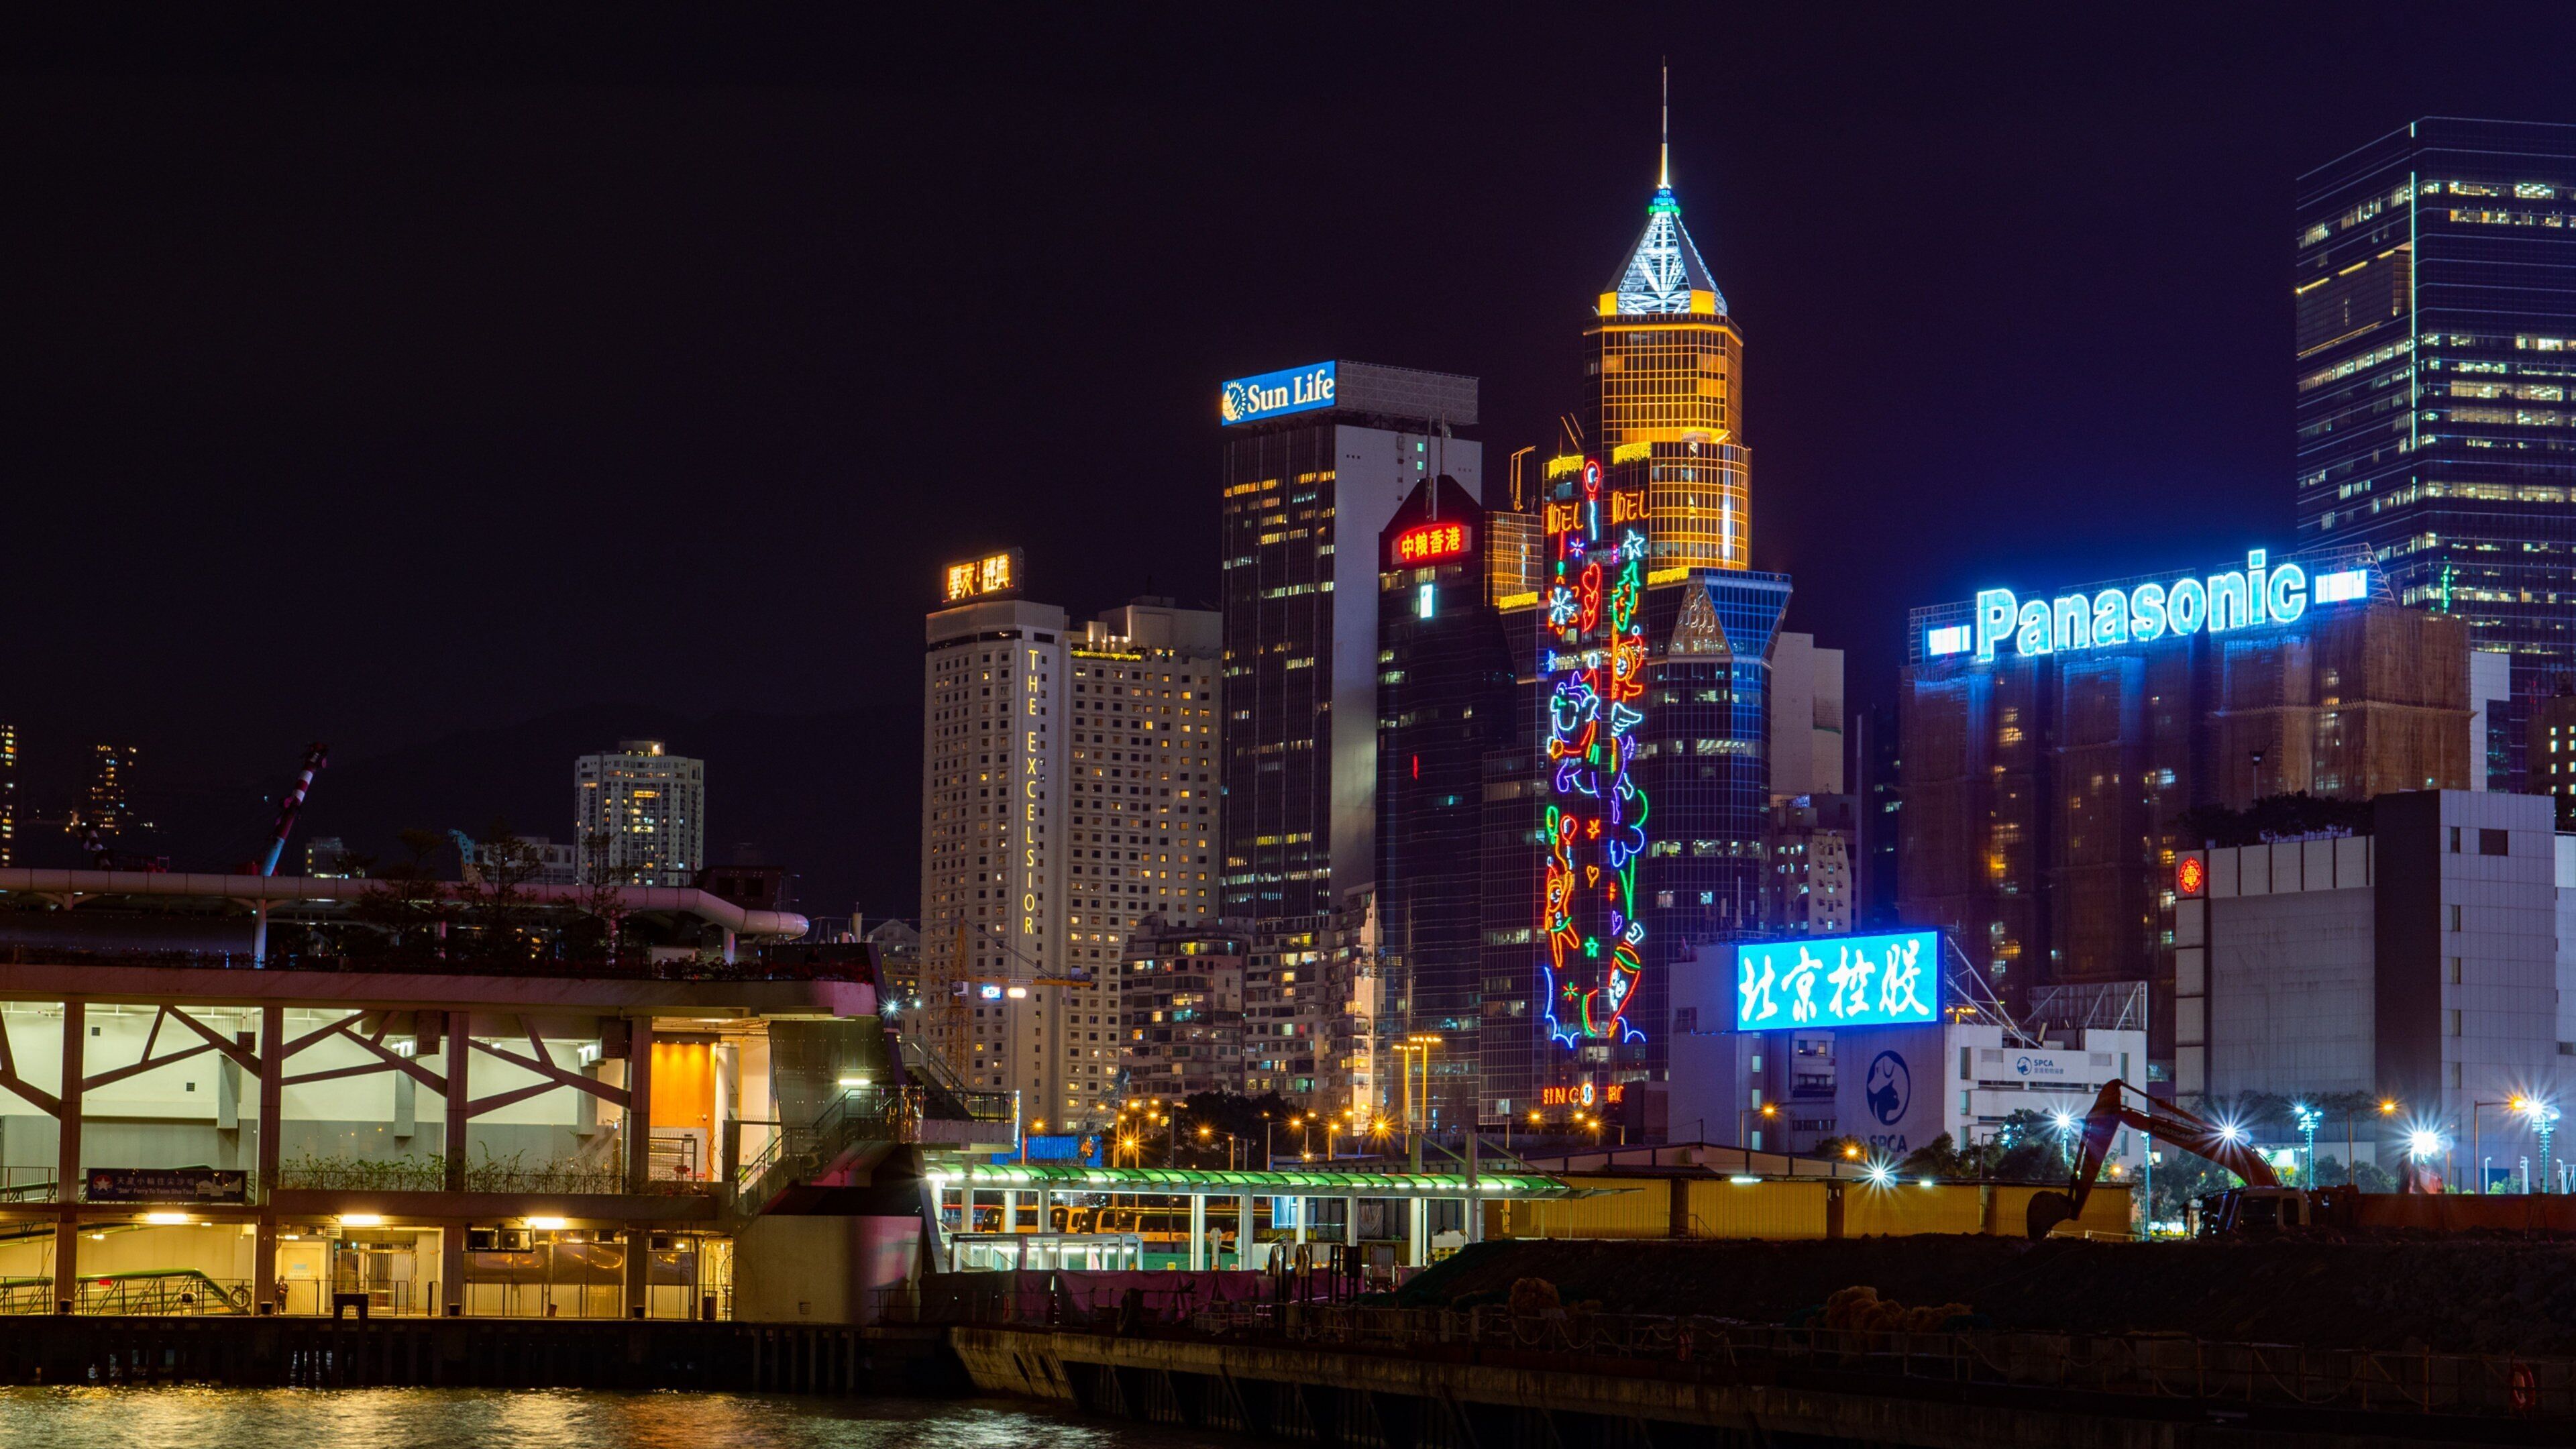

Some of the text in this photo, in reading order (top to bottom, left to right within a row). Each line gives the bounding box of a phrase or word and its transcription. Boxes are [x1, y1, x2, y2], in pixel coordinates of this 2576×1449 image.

[1247, 369, 1334, 413] Sun Life
[1976, 549, 2306, 662] Panasonic
[1024, 649, 1038, 935] THE EXCELSIOR
[1738, 938, 1930, 1024] 北京控股
[2034, 1059, 2053, 1067] SPCA
[1869, 1134, 1908, 1153] SPCA
